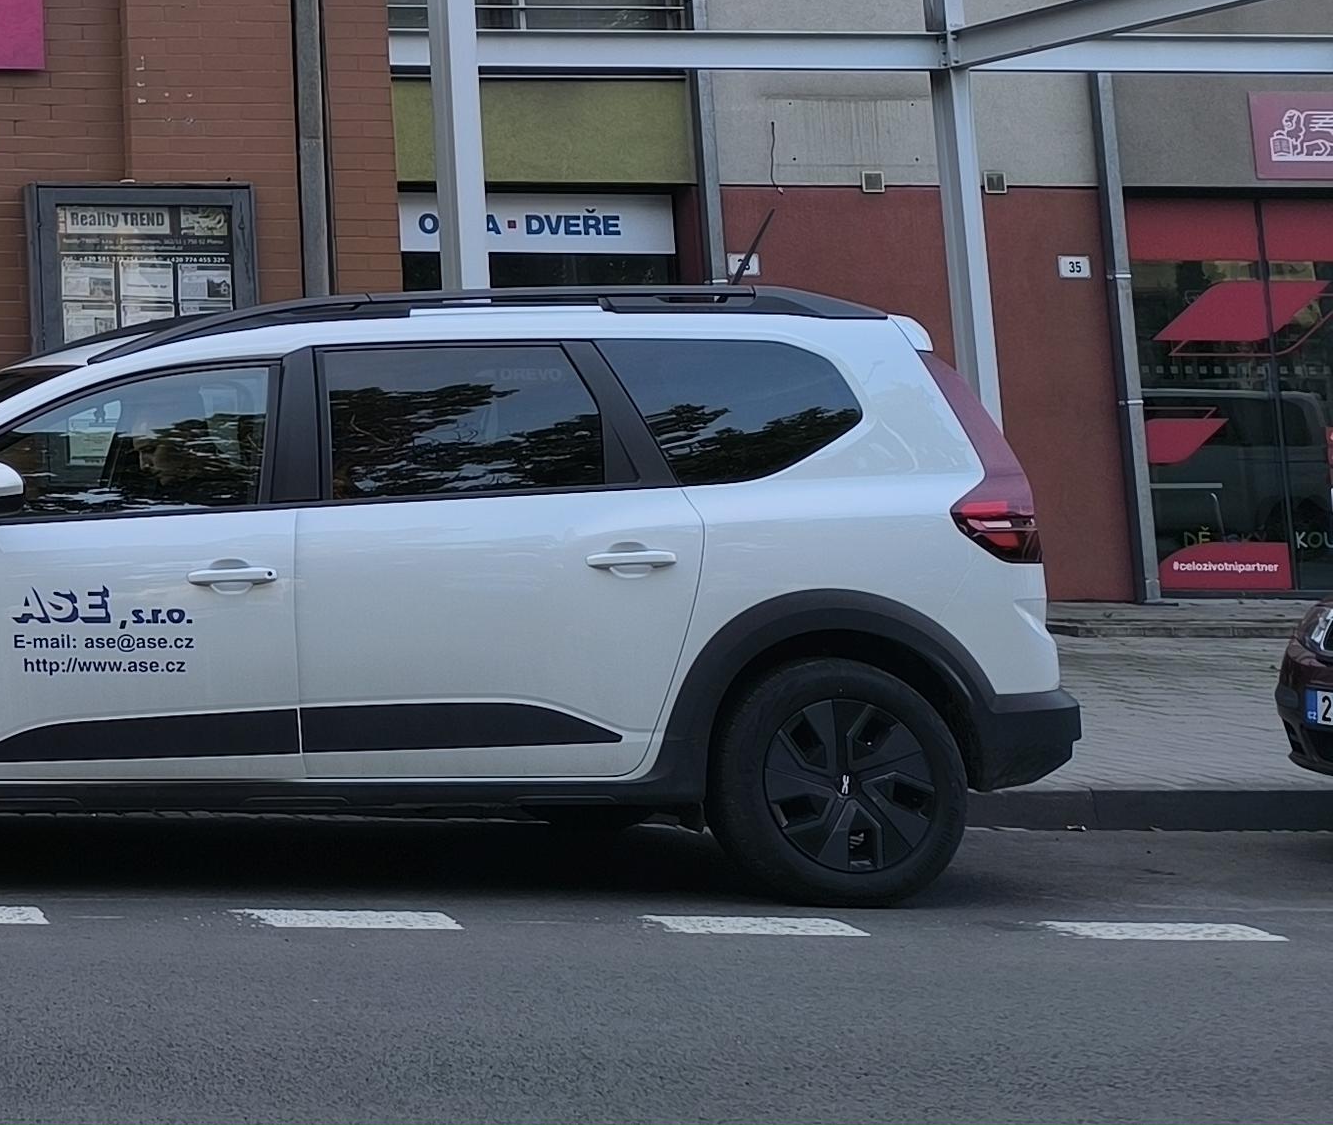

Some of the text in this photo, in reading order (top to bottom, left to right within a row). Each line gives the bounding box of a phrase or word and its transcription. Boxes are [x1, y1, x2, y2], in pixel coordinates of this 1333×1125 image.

[70, 212, 119, 227] Reality
[122, 212, 165, 226] TREND
[525, 209, 621, 236] DVEŘE
[1068, 261, 1082, 273] 35
[1172, 560, 1279, 573] #celozivotnipartner
[12, 585, 111, 624] ASE
[14, 634, 194, 652] E-mail: ase@ase.cz
[23, 657, 186, 676] http://www.ase.cz
[1322, 695, 1332, 722] 2
